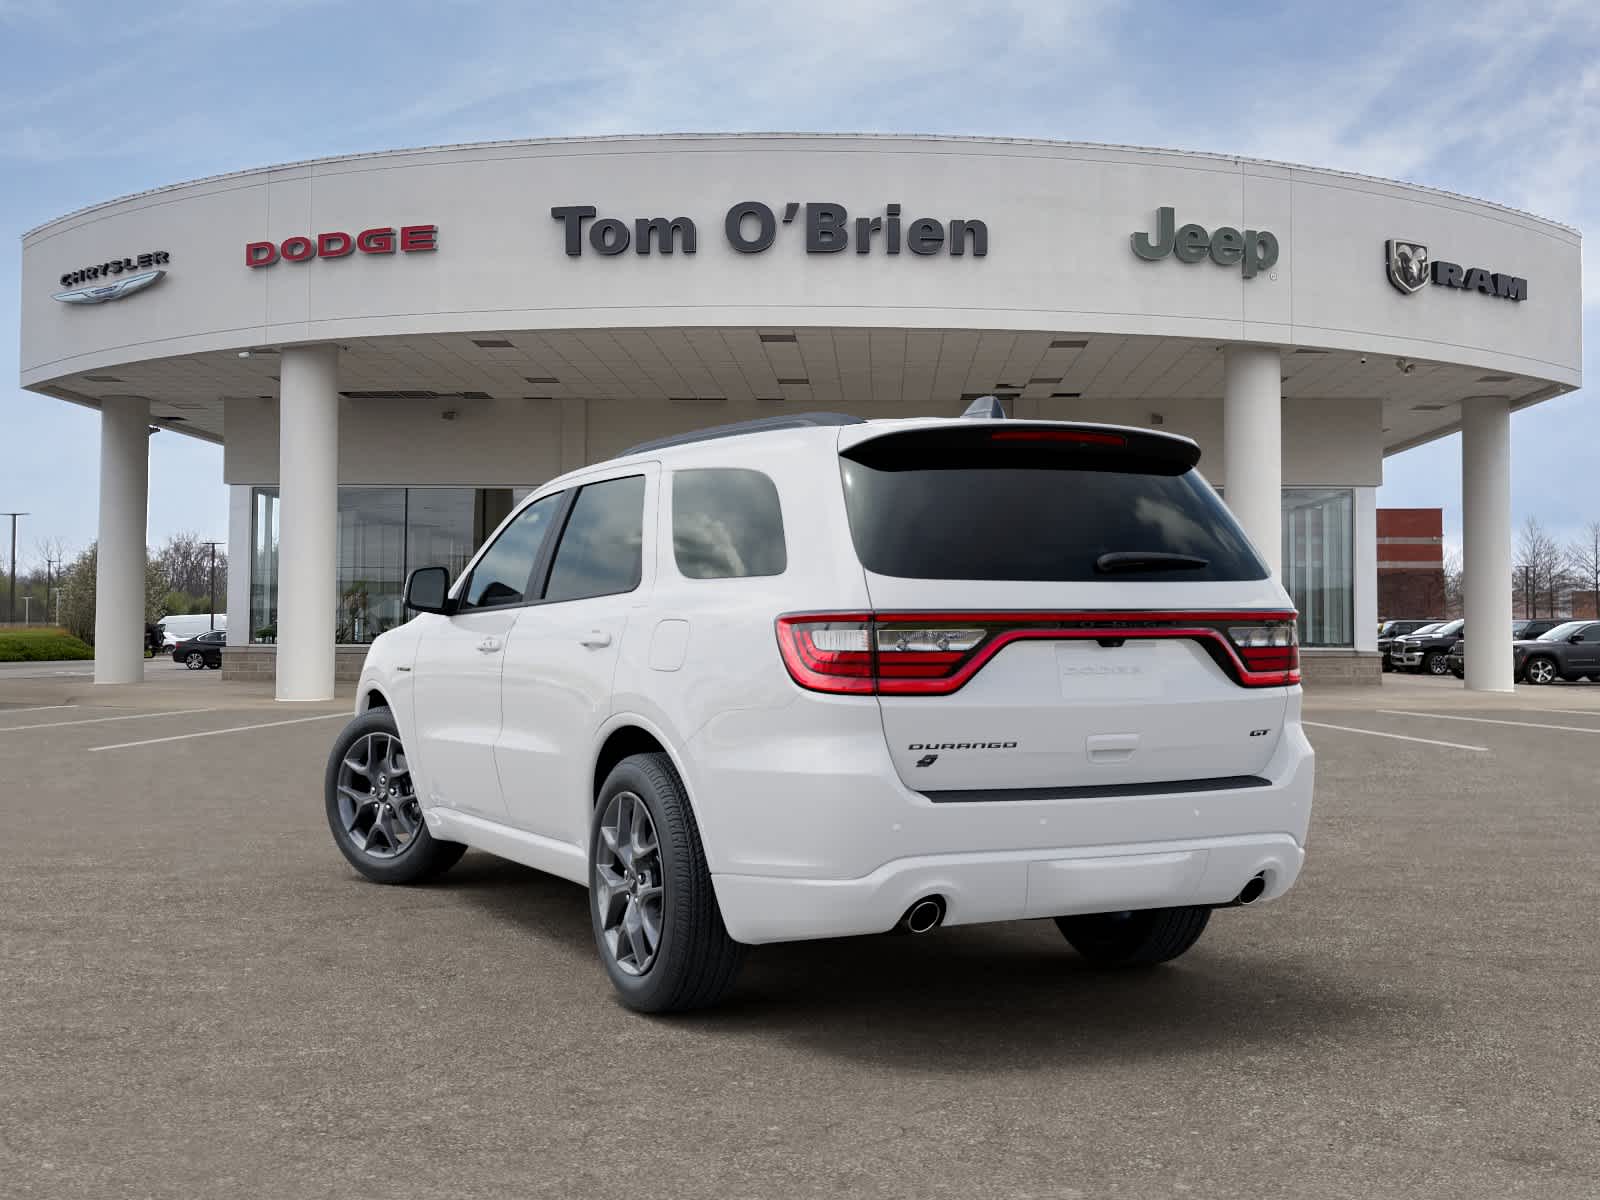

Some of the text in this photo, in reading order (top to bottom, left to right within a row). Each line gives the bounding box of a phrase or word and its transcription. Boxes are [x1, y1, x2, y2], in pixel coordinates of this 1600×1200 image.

[246, 224, 438, 269] DODGE
[551, 201, 988, 256] Tom O'Brien
[1130, 206, 1279, 279] Jeep
[60, 250, 170, 286] CHRYSLER
[1430, 260, 1527, 301] RAM
[908, 741, 1018, 751] DURANGO
[1249, 728, 1271, 738] GT
